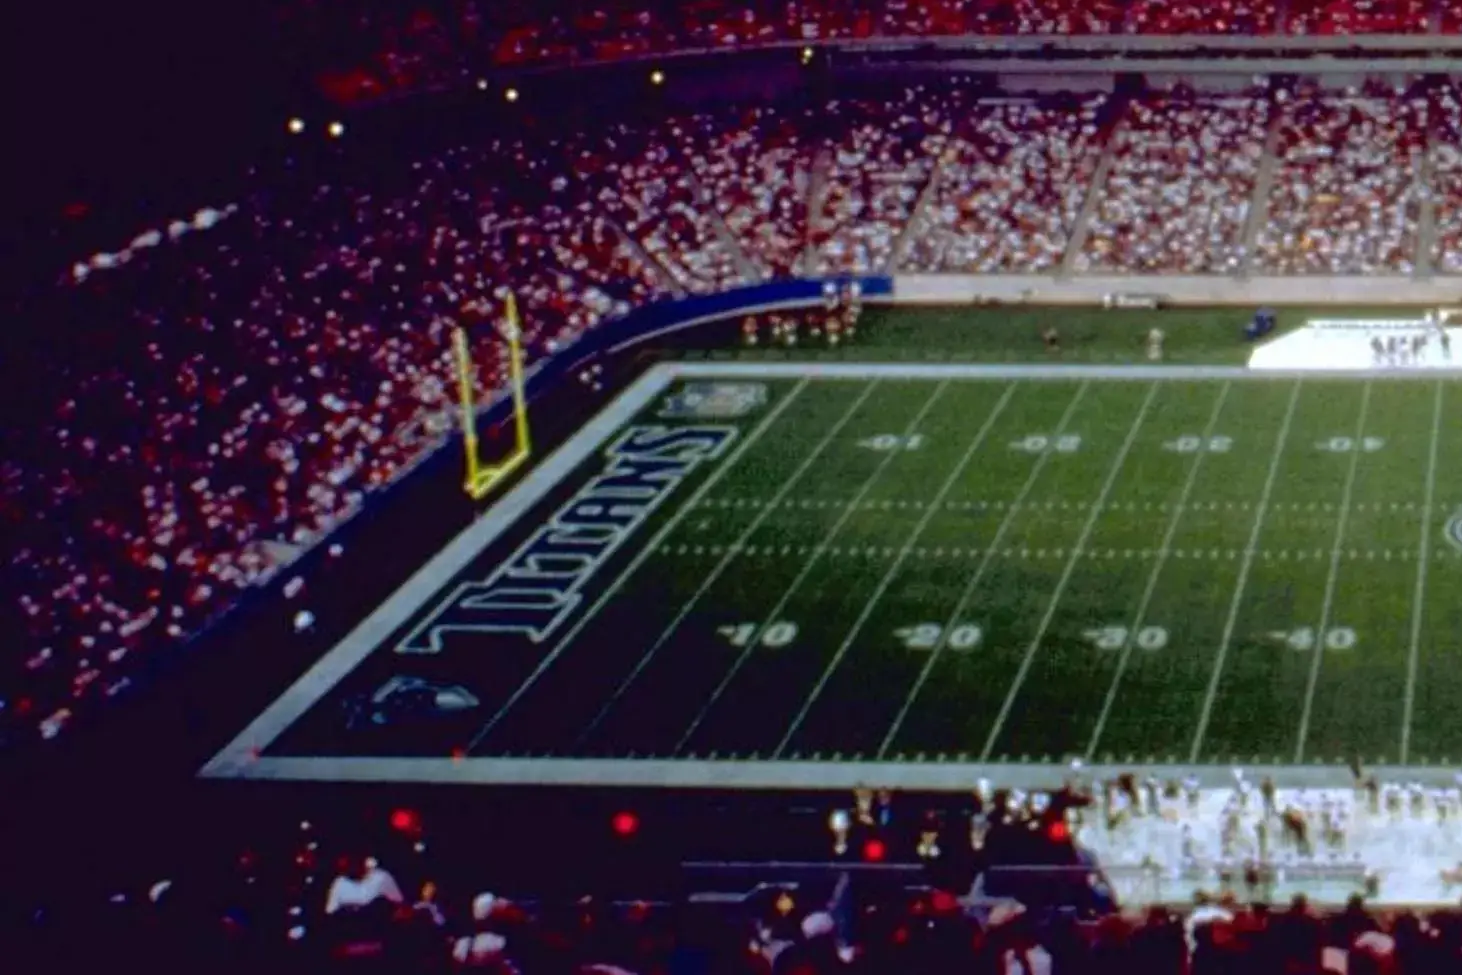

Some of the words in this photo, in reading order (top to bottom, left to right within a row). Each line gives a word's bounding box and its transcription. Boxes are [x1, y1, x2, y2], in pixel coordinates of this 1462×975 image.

[729, 623, 798, 648] 10
[906, 623, 982, 650] 20
[1097, 626, 1168, 650] 30
[1288, 626, 1357, 650] 40
